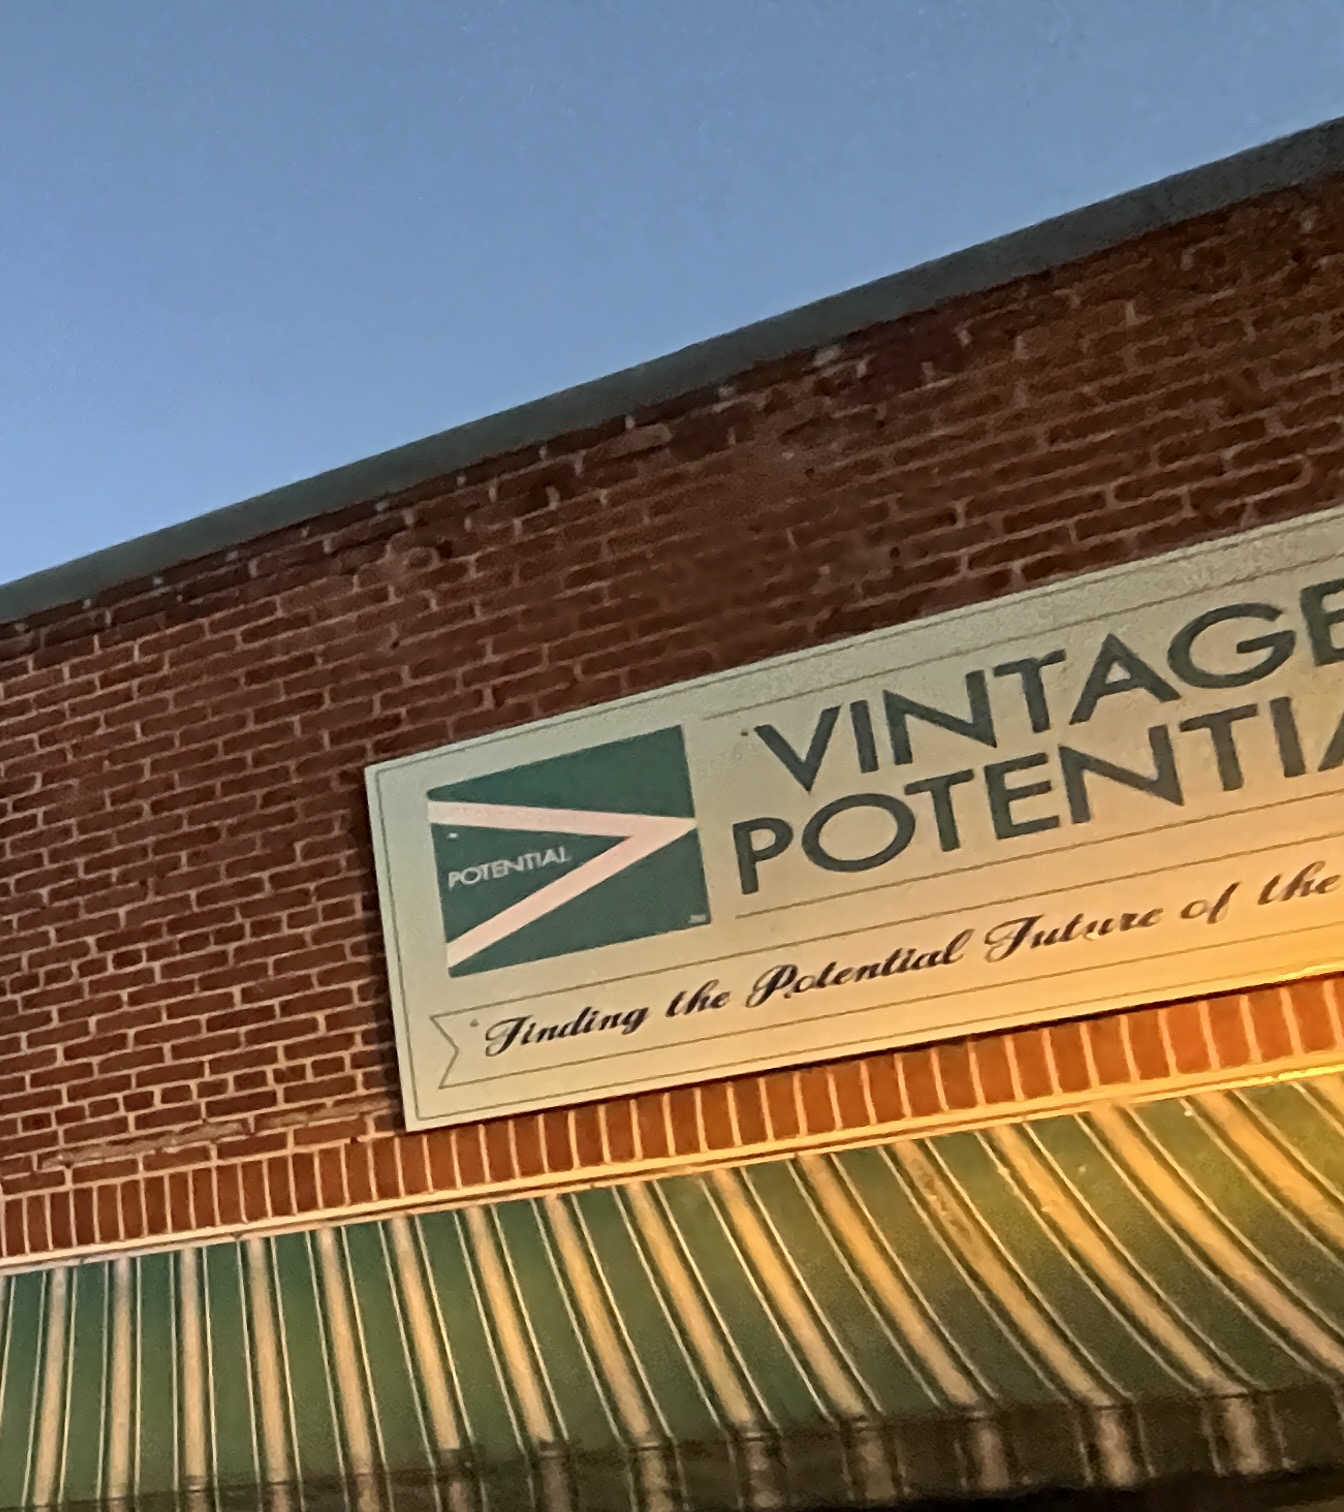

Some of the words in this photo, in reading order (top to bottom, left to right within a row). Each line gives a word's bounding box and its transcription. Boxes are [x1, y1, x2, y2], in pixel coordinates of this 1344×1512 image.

[753, 578, 1344, 793] VINTAGE
[447, 846, 571, 891] POTENTIAL
[732, 696, 1344, 895] POTENTI
[484, 1006, 651, 1058] Finding
[665, 978, 731, 1018] the
[746, 928, 973, 1011] Potential
[984, 904, 1165, 964] Future
[1179, 881, 1241, 927] of
[1259, 860, 1343, 911] the
